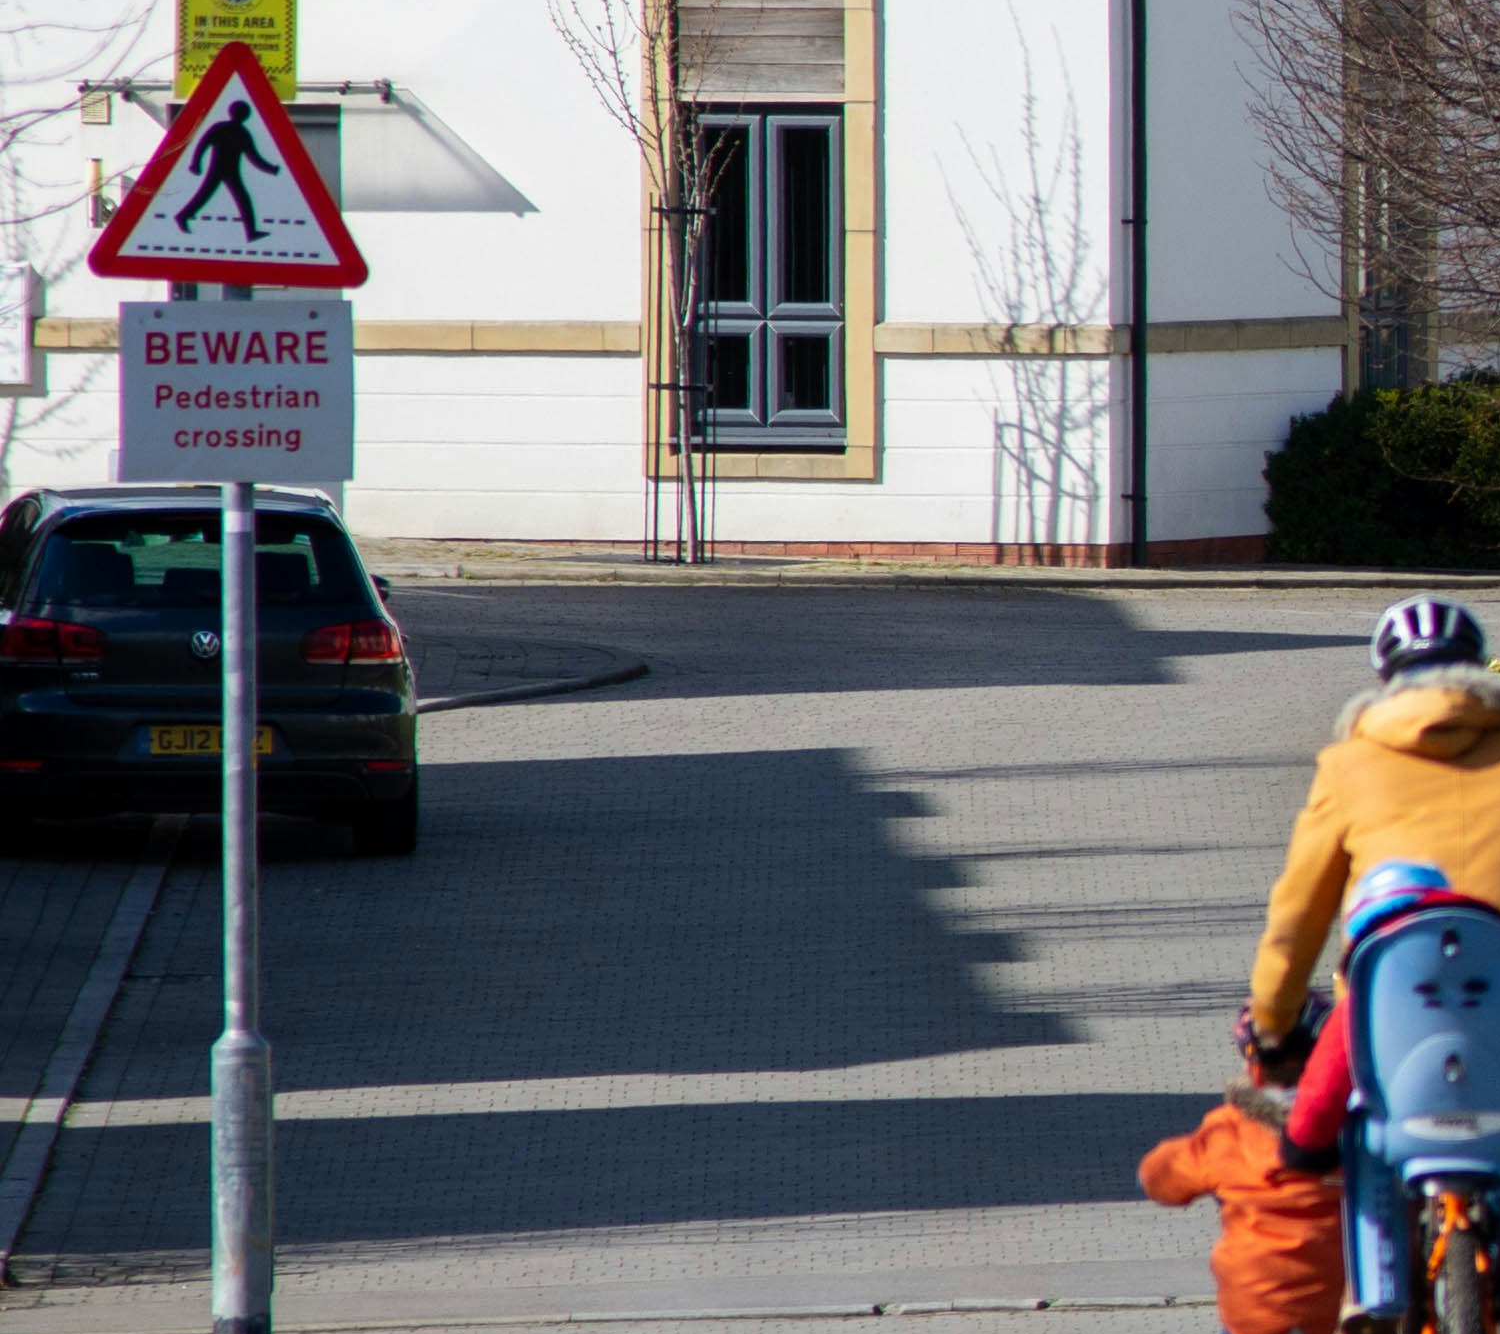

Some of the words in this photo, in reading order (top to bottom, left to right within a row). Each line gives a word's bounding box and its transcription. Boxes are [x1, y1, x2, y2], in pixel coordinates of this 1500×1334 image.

[194, 16, 208, 28] IN
[212, 16, 240, 28] THIS
[242, 16, 275, 28] AREA
[144, 330, 330, 365] BEWARE
[154, 384, 320, 410] Pedestrian
[173, 425, 303, 453] crossing
[158, 729, 211, 750] GJ12
